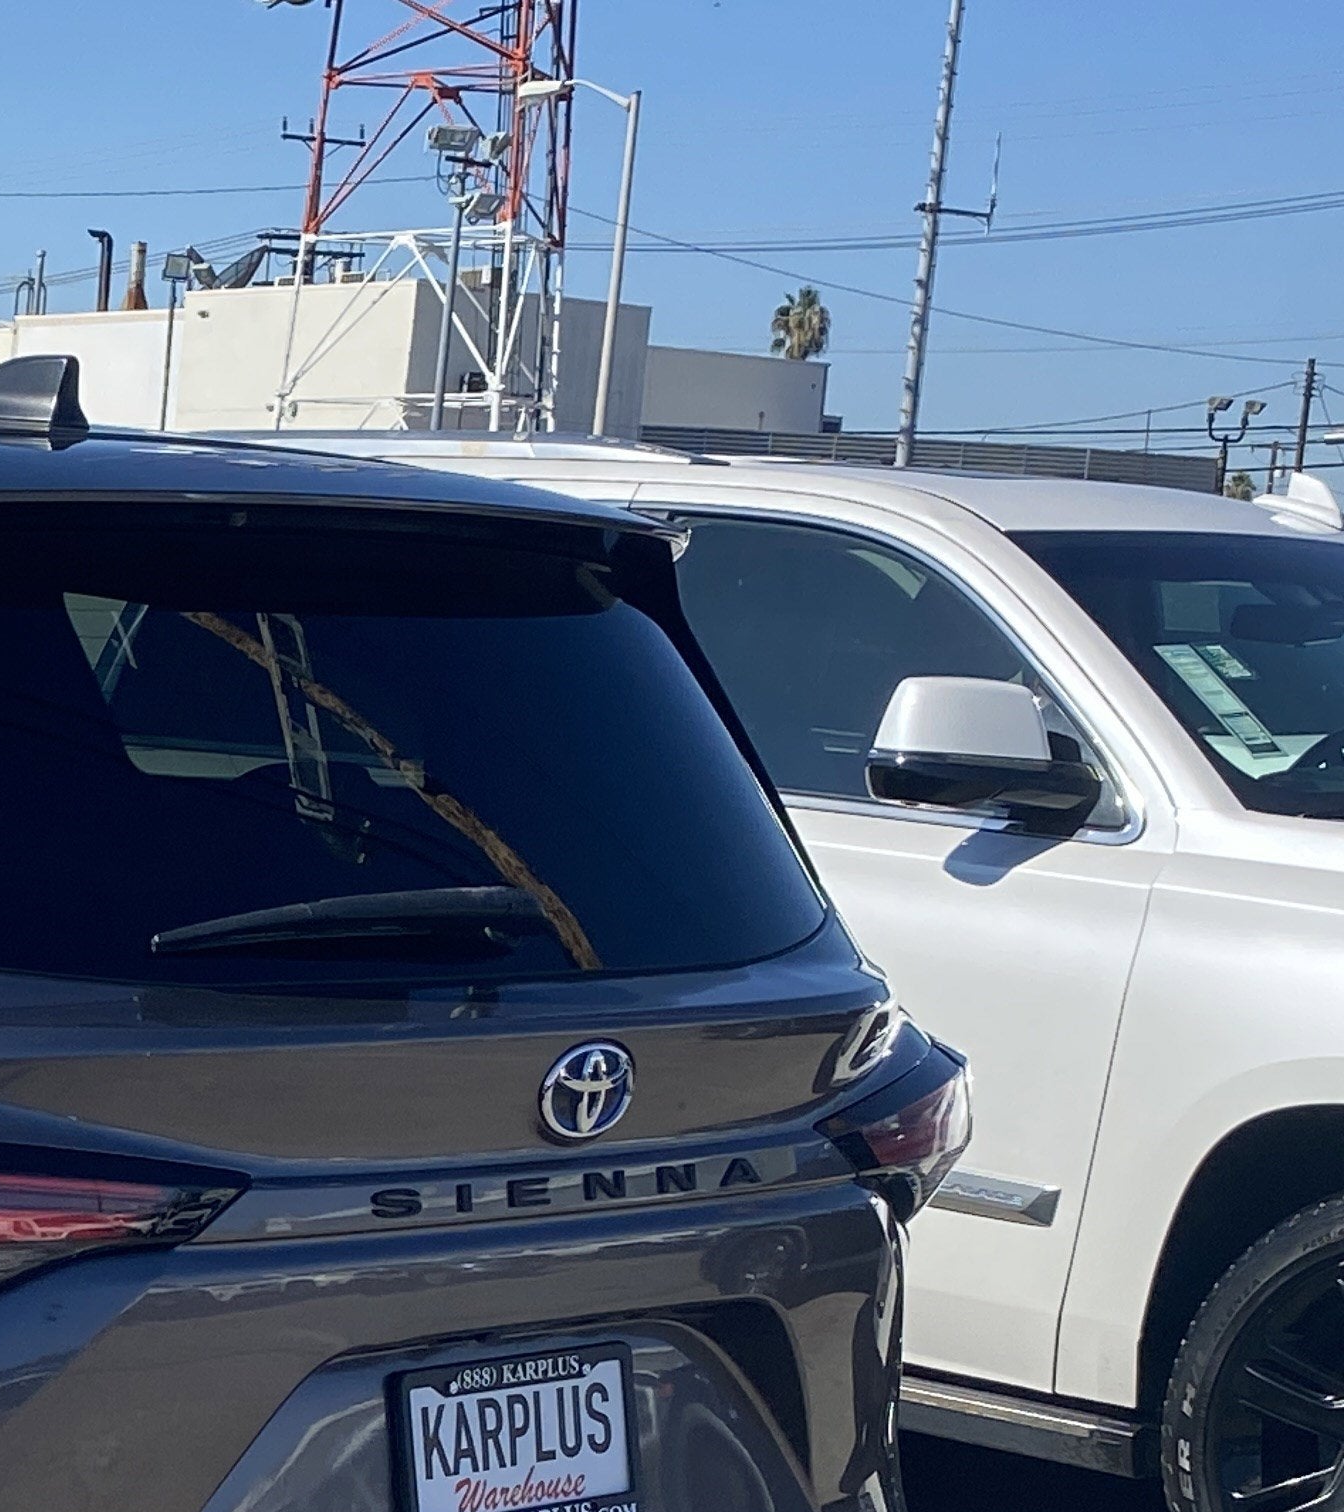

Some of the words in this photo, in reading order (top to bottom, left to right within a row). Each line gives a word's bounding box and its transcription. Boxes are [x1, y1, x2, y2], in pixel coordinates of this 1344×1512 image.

[370, 1157, 763, 1219] SIENNA
[456, 1366, 498, 1390] (888)
[501, 1354, 580, 1385] KARPLUS
[419, 1381, 612, 1481] KARPLUS
